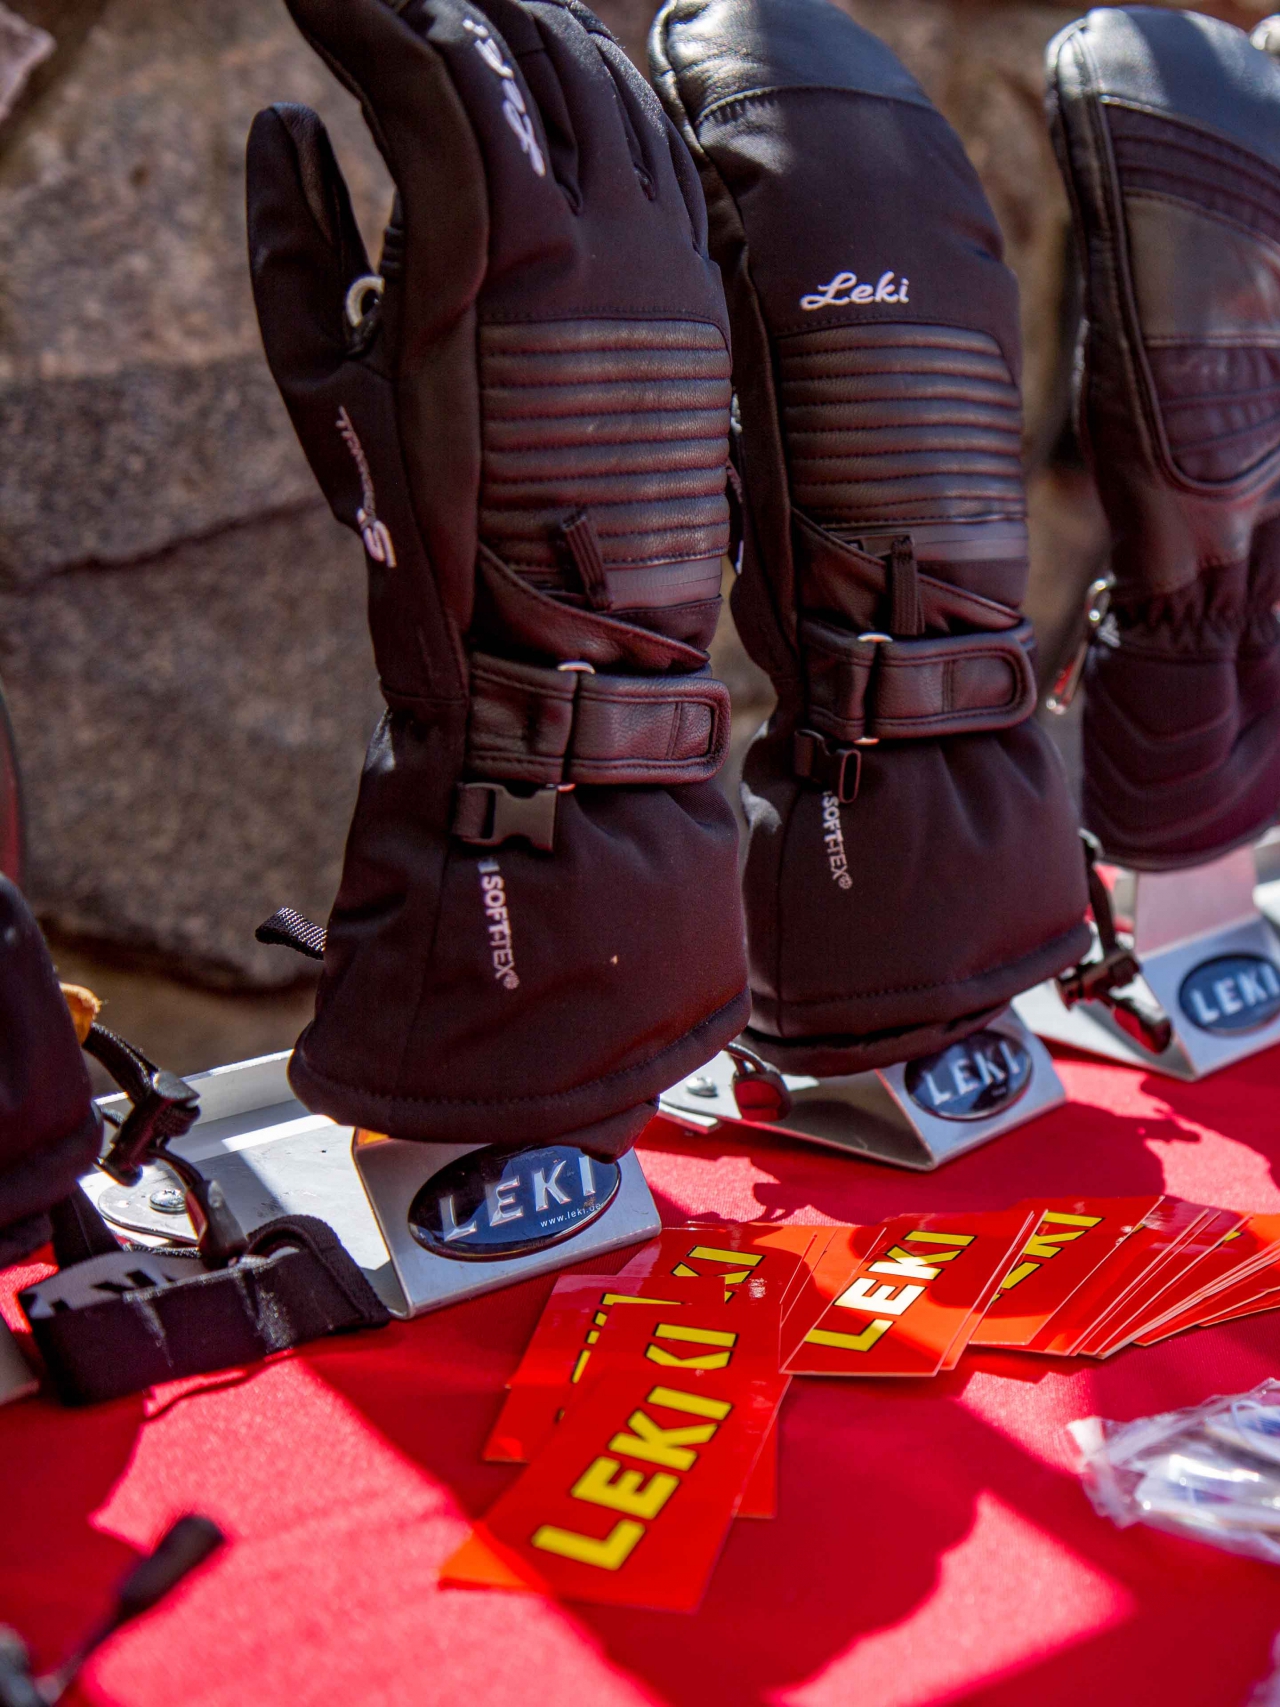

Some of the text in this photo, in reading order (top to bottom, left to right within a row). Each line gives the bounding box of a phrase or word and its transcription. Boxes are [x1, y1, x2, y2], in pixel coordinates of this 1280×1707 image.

[799, 270, 910, 311] Leki
[922, 1040, 1021, 1106] LEKI
[438, 1154, 597, 1243] LEKI
[792, 1229, 979, 1353] LEKI
[529, 1384, 736, 1573] LEKI
